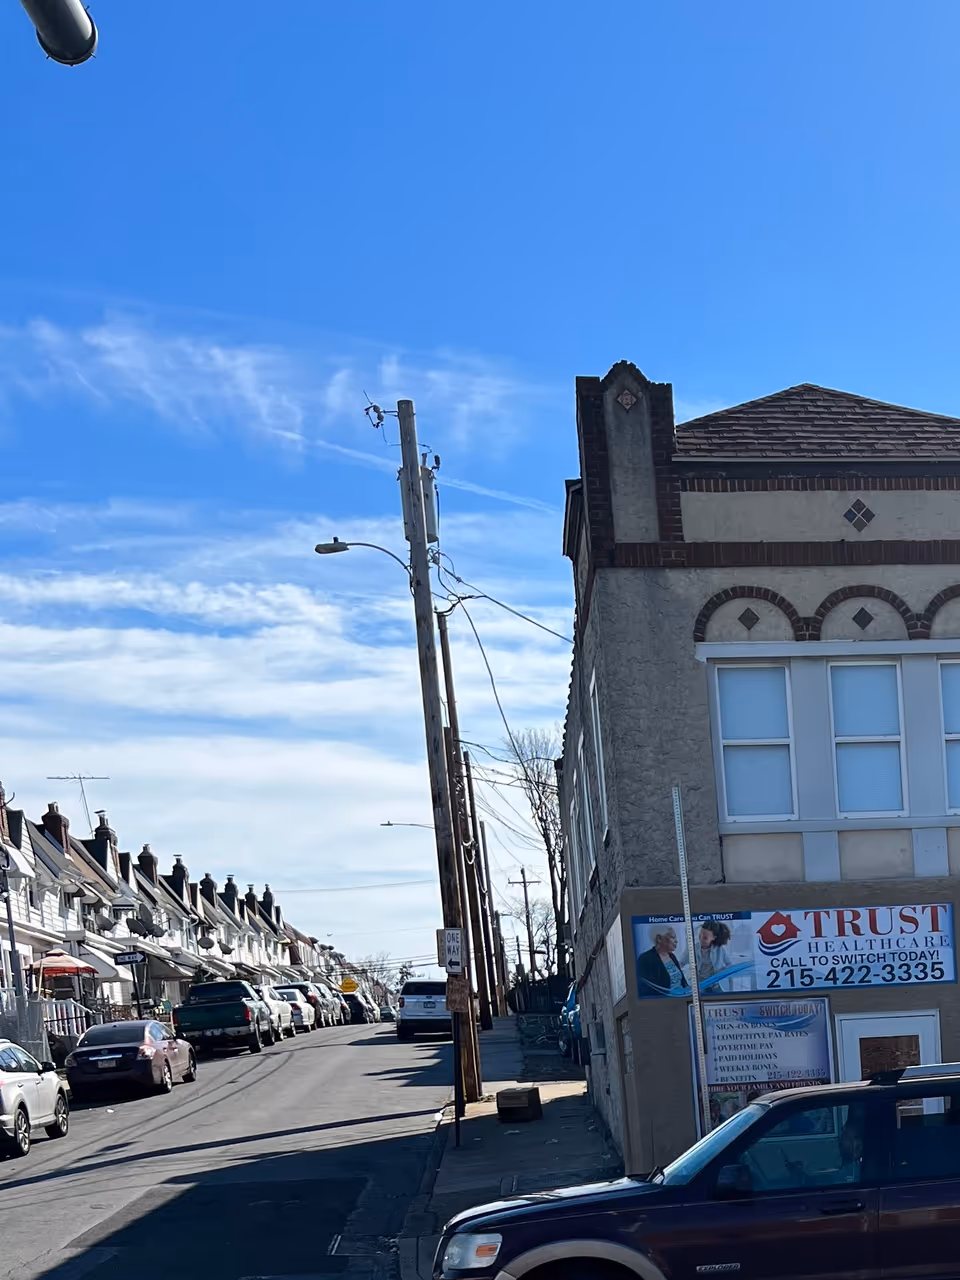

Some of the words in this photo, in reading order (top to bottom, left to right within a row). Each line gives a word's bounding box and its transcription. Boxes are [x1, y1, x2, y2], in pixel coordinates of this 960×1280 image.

[712, 913, 734, 921] TRUST
[804, 905, 947, 938] TRUST
[447, 933, 459, 943] ONE
[807, 935, 950, 953] HEALTHCARE
[447, 945, 459, 955] WAY
[770, 957, 807, 968] CALL
[810, 955, 829, 966] TO
[832, 952, 887, 965] SWITCH
[889, 950, 939, 962] TODAY!
[766, 961, 945, 988] 215-422-3335
[707, 1008, 746, 1018] TRUST
[760, 1003, 791, 1017] SWITCH
[768, 1031, 783, 1039] PAY
[785, 1030, 809, 1038] RATES
[717, 1043, 758, 1051] OVERTIME
[759, 1042, 775, 1050] PAY
[718, 1054, 737, 1062] PAID
[738, 1052, 778, 1061] HOLIDAYS
[719, 1064, 751, 1072] WEEKLY
[752, 1063, 778, 1071] BONUS
[697, 1263, 740, 1272] EXPLORER
